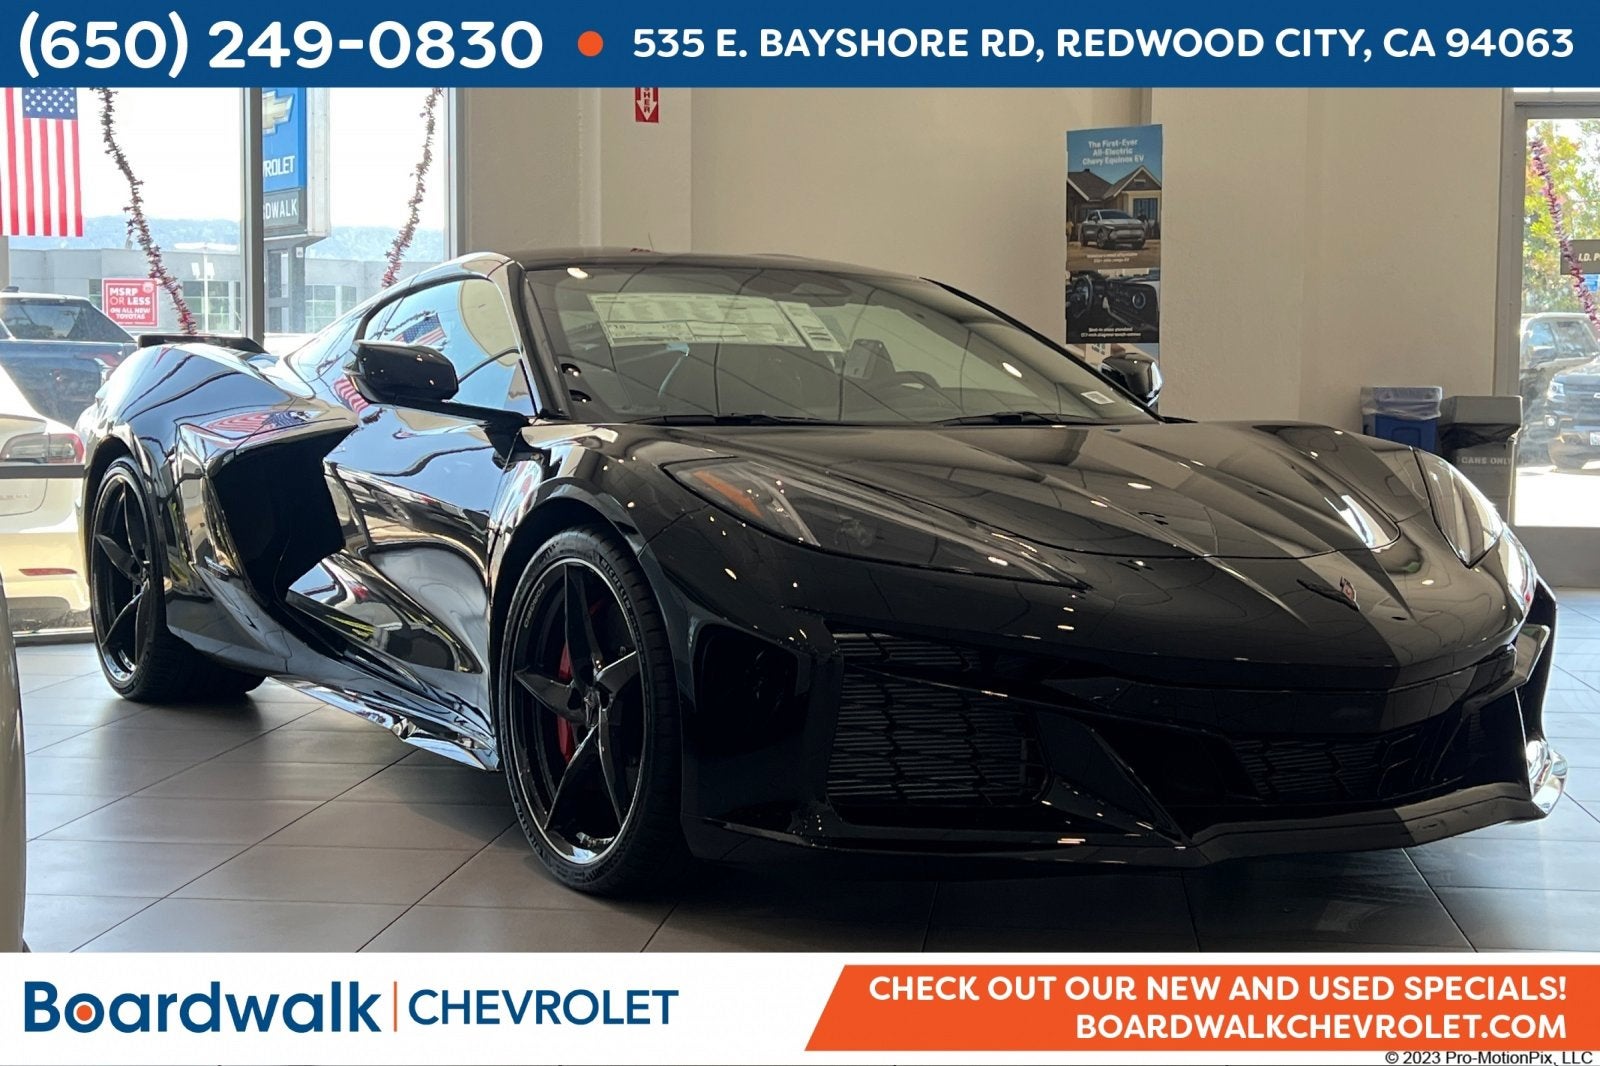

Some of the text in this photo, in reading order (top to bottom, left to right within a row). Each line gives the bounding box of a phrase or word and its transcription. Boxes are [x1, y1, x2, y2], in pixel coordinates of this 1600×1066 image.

[1134, 154, 1144, 162] EV
[263, 198, 298, 220] DWALK
[110, 287, 138, 296] MSRP
[110, 296, 151, 305] OR LESS
[1461, 456, 1488, 464] CANS
